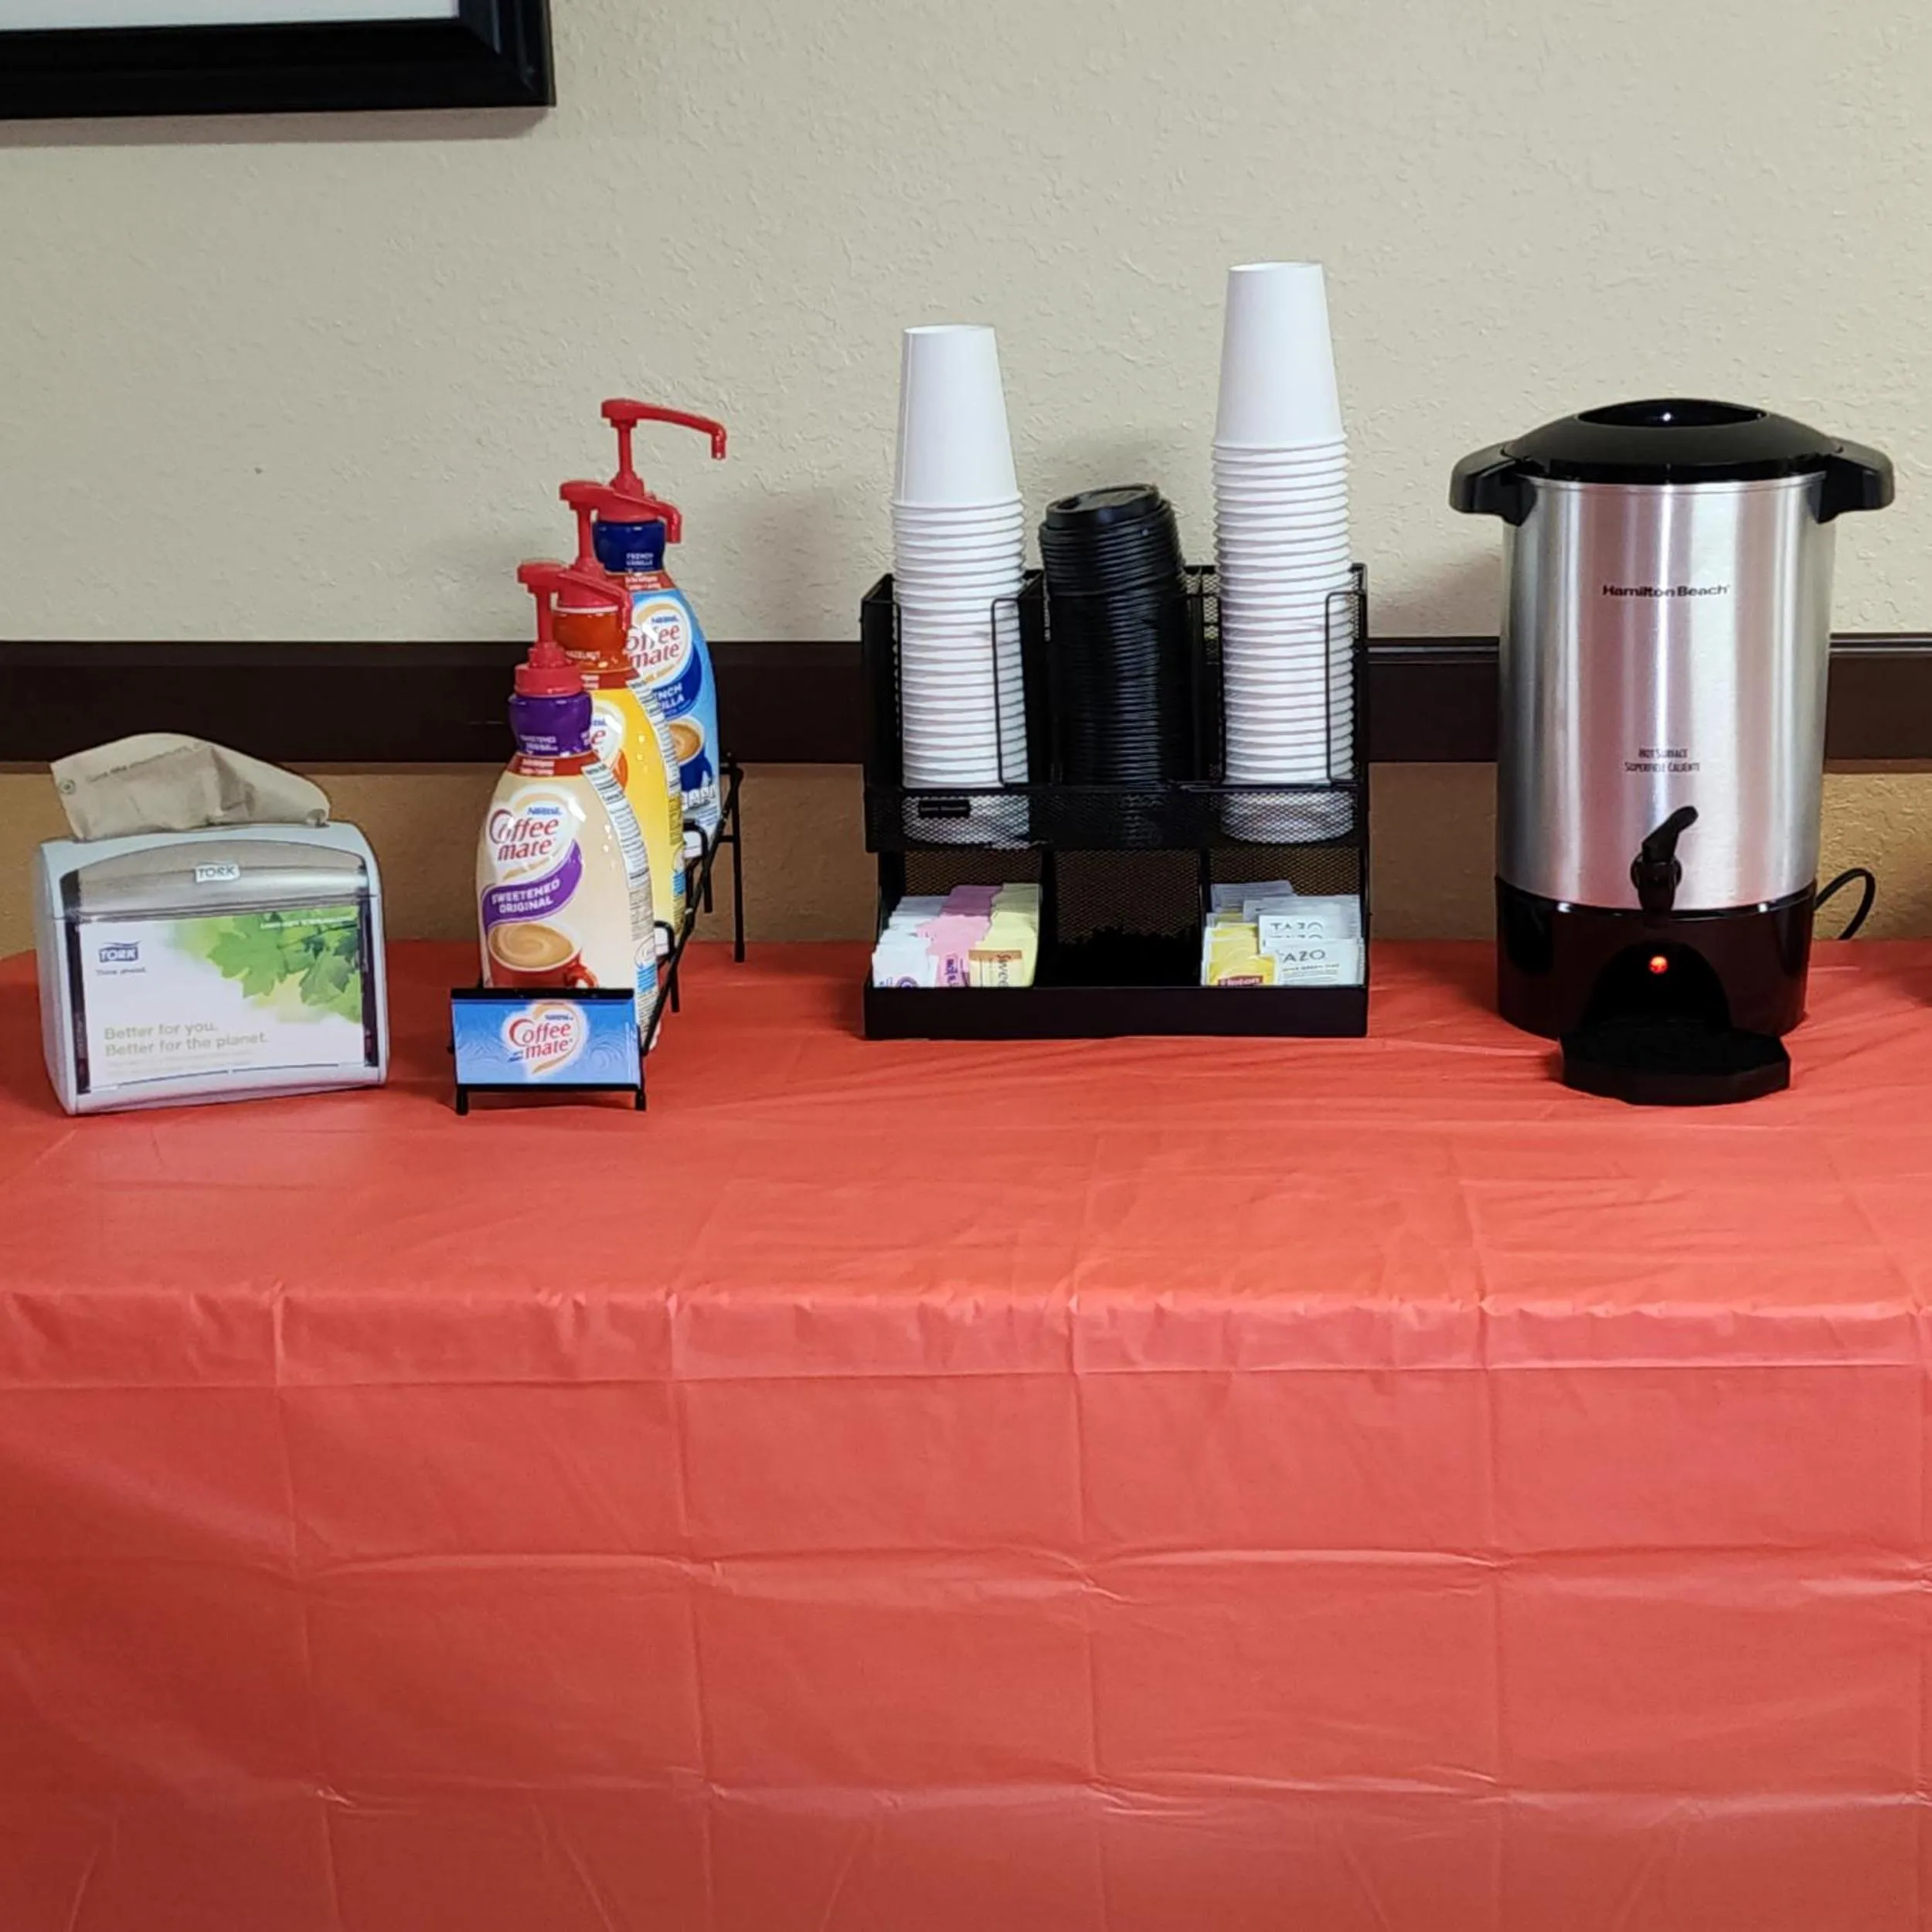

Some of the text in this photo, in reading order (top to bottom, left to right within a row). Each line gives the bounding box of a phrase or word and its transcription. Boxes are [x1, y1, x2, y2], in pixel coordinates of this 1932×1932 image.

[1602, 584, 1727, 597] Hamilton Beach
[489, 809, 559, 844] Coffee
[497, 839, 552, 861] mate
[198, 866, 236, 878] TORK
[492, 879, 560, 905] SWEETENED
[498, 896, 553, 913] ORIGINAL
[100, 948, 138, 961] TORK
[104, 1022, 219, 1039] Better for you.
[509, 1019, 571, 1047] Coffee
[105, 1031, 268, 1057] Better for the planet.
[526, 1039, 569, 1059] mate
